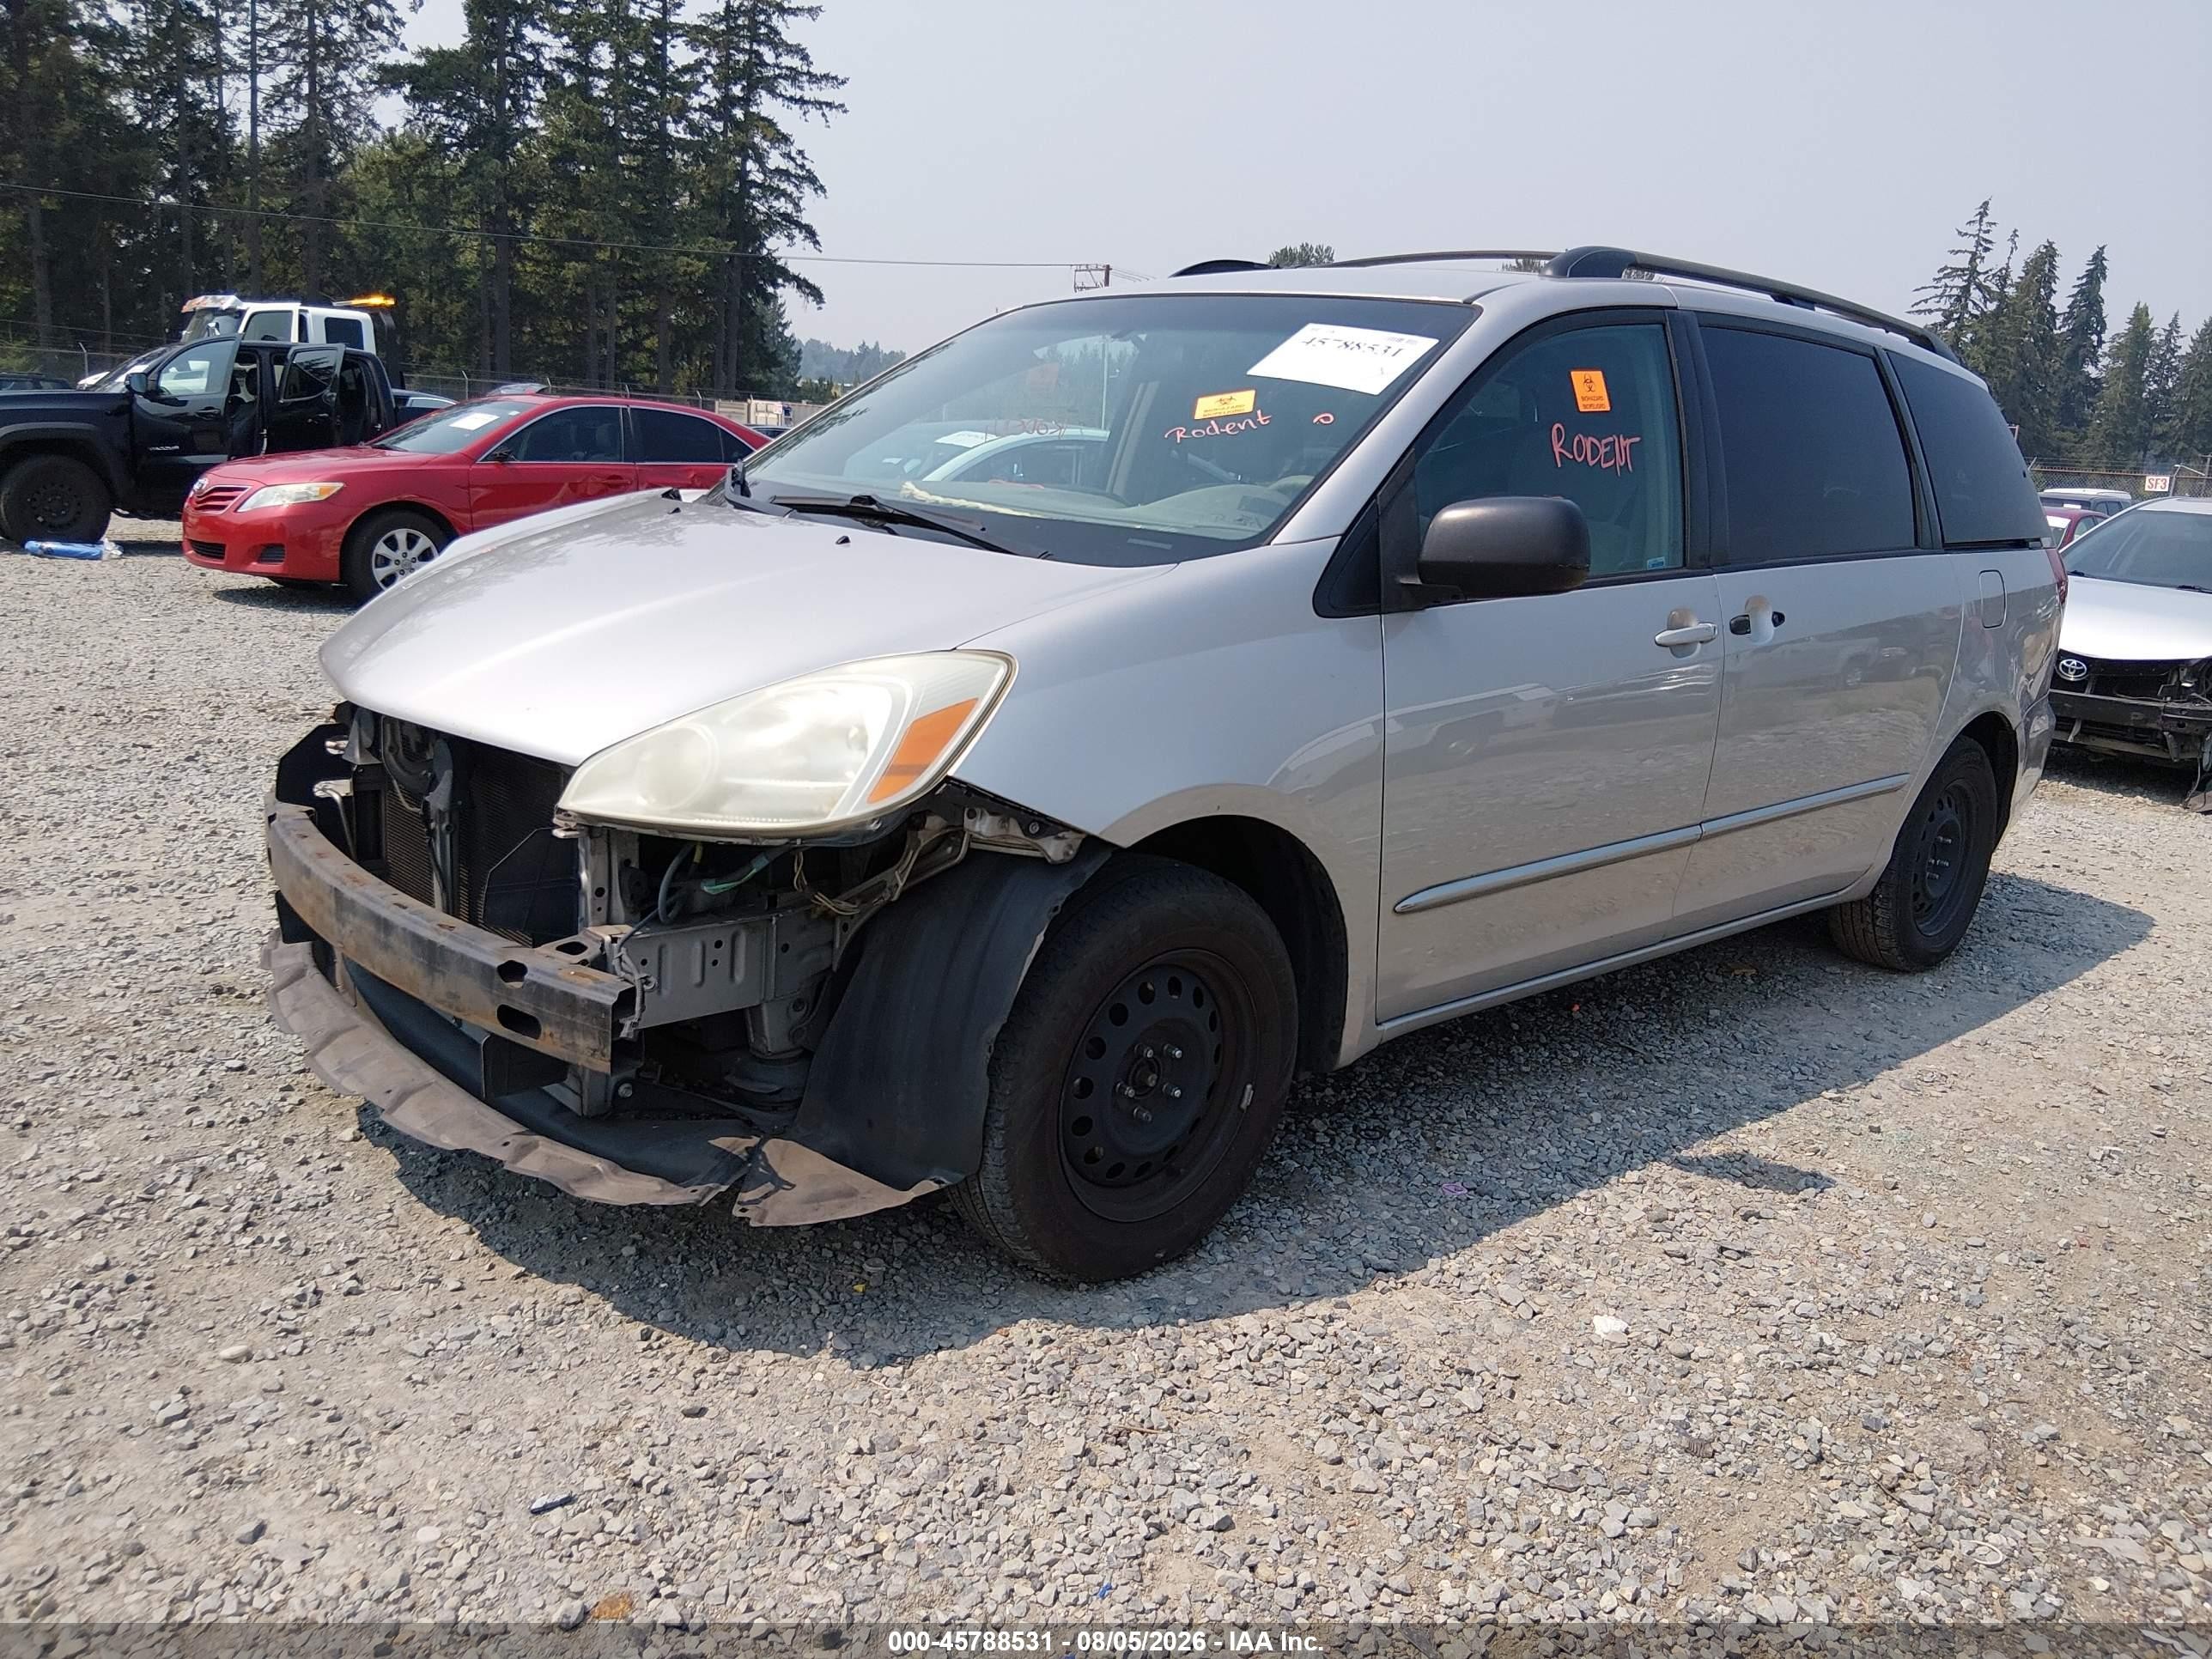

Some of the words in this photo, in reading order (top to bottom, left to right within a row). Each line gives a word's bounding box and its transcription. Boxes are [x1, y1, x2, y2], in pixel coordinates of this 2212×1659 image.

[1164, 409, 1272, 444] Rodent
[1551, 422, 1642, 477] RODENT
[2148, 478, 2167, 489] SF3
